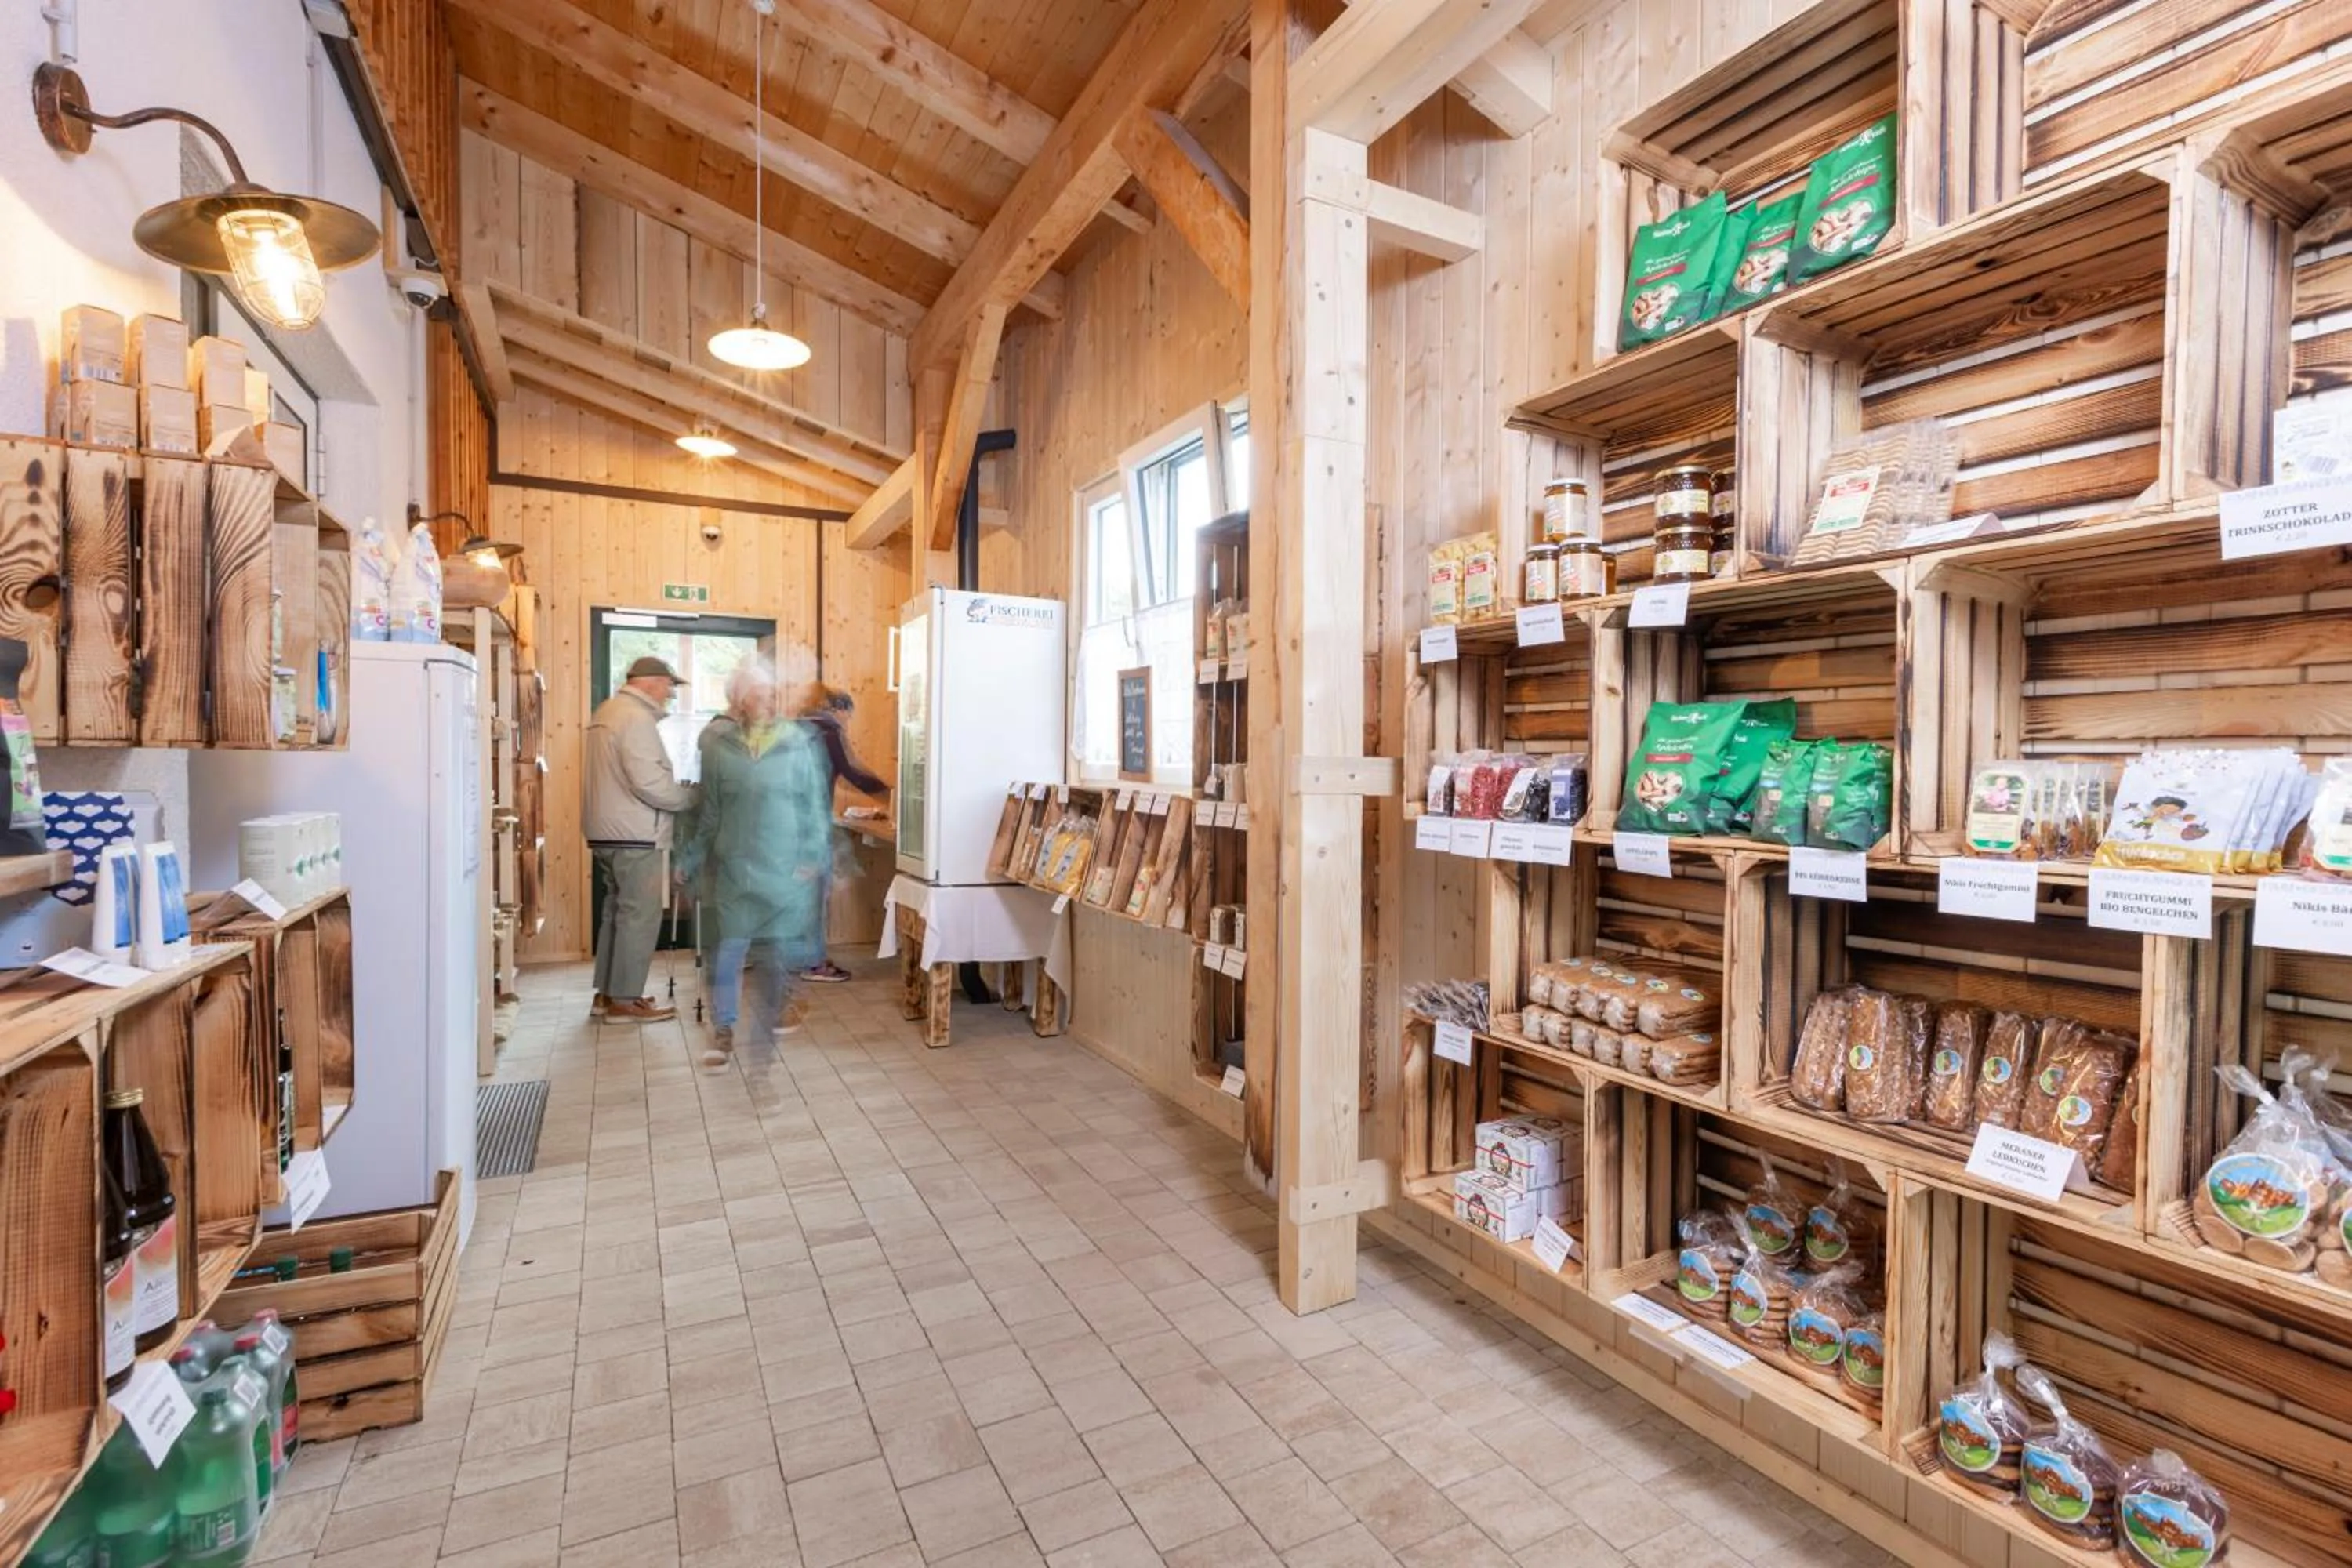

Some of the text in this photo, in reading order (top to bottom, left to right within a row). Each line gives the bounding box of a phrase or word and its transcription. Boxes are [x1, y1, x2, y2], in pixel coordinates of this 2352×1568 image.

[2263, 503, 2318, 519] ZOTTER
[989, 604, 1054, 620] FISCHEREI
[2104, 890, 2194, 906] FRUCHTGUMMI
[2100, 902, 2198, 920] BIO BENGELCHEN
